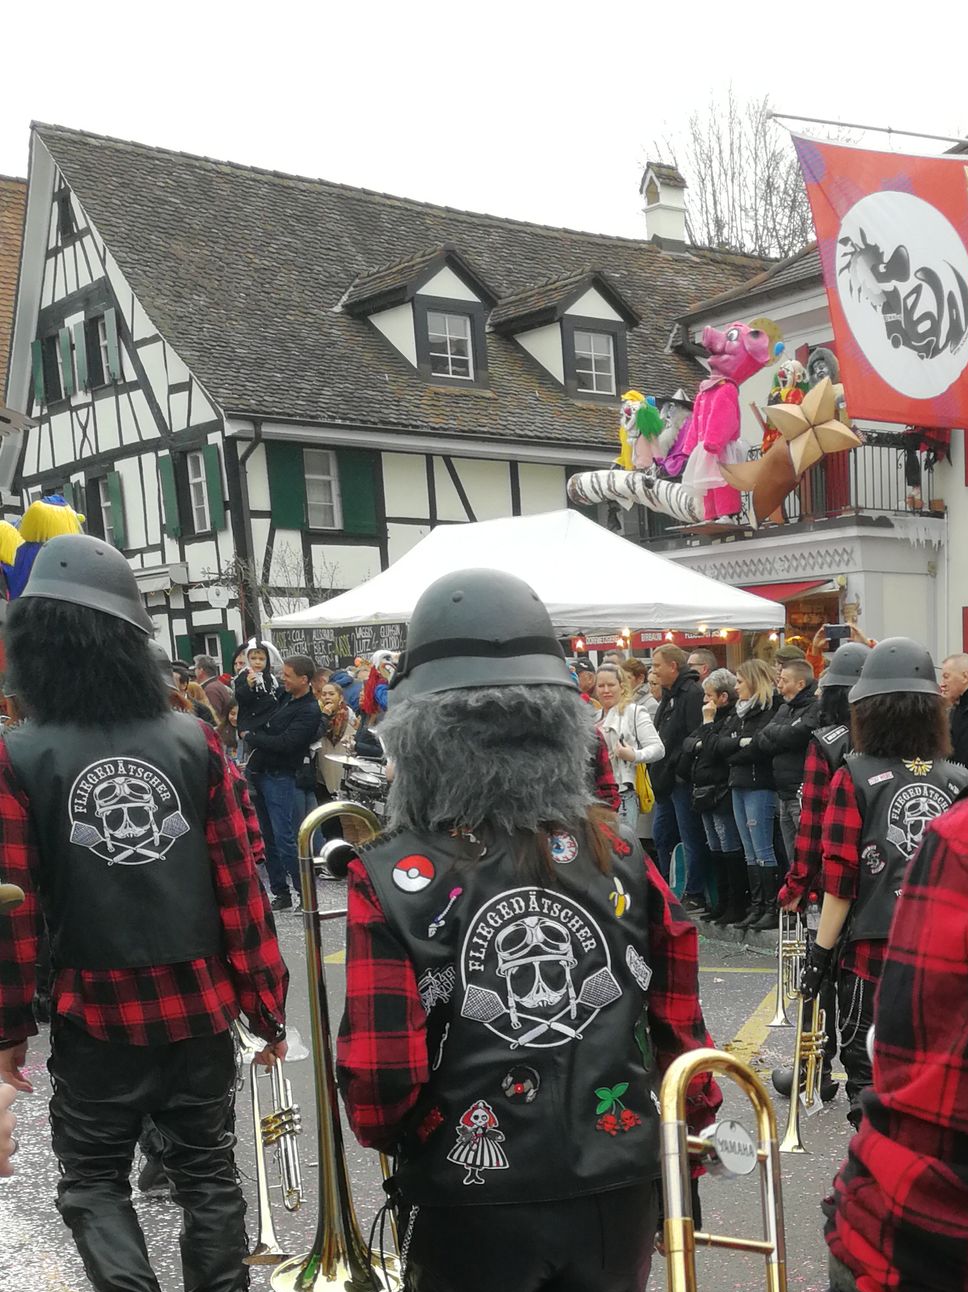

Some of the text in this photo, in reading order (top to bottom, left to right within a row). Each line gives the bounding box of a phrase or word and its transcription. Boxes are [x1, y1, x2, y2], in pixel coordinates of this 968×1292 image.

[74, 760, 171, 814] FLIEGEDÄTSCHER
[891, 785, 949, 821] FLIEGEDÄTSCH
[468, 891, 598, 972] FLIEGEDÄTSCHER
[717, 1138, 755, 1158] YAMAHA
